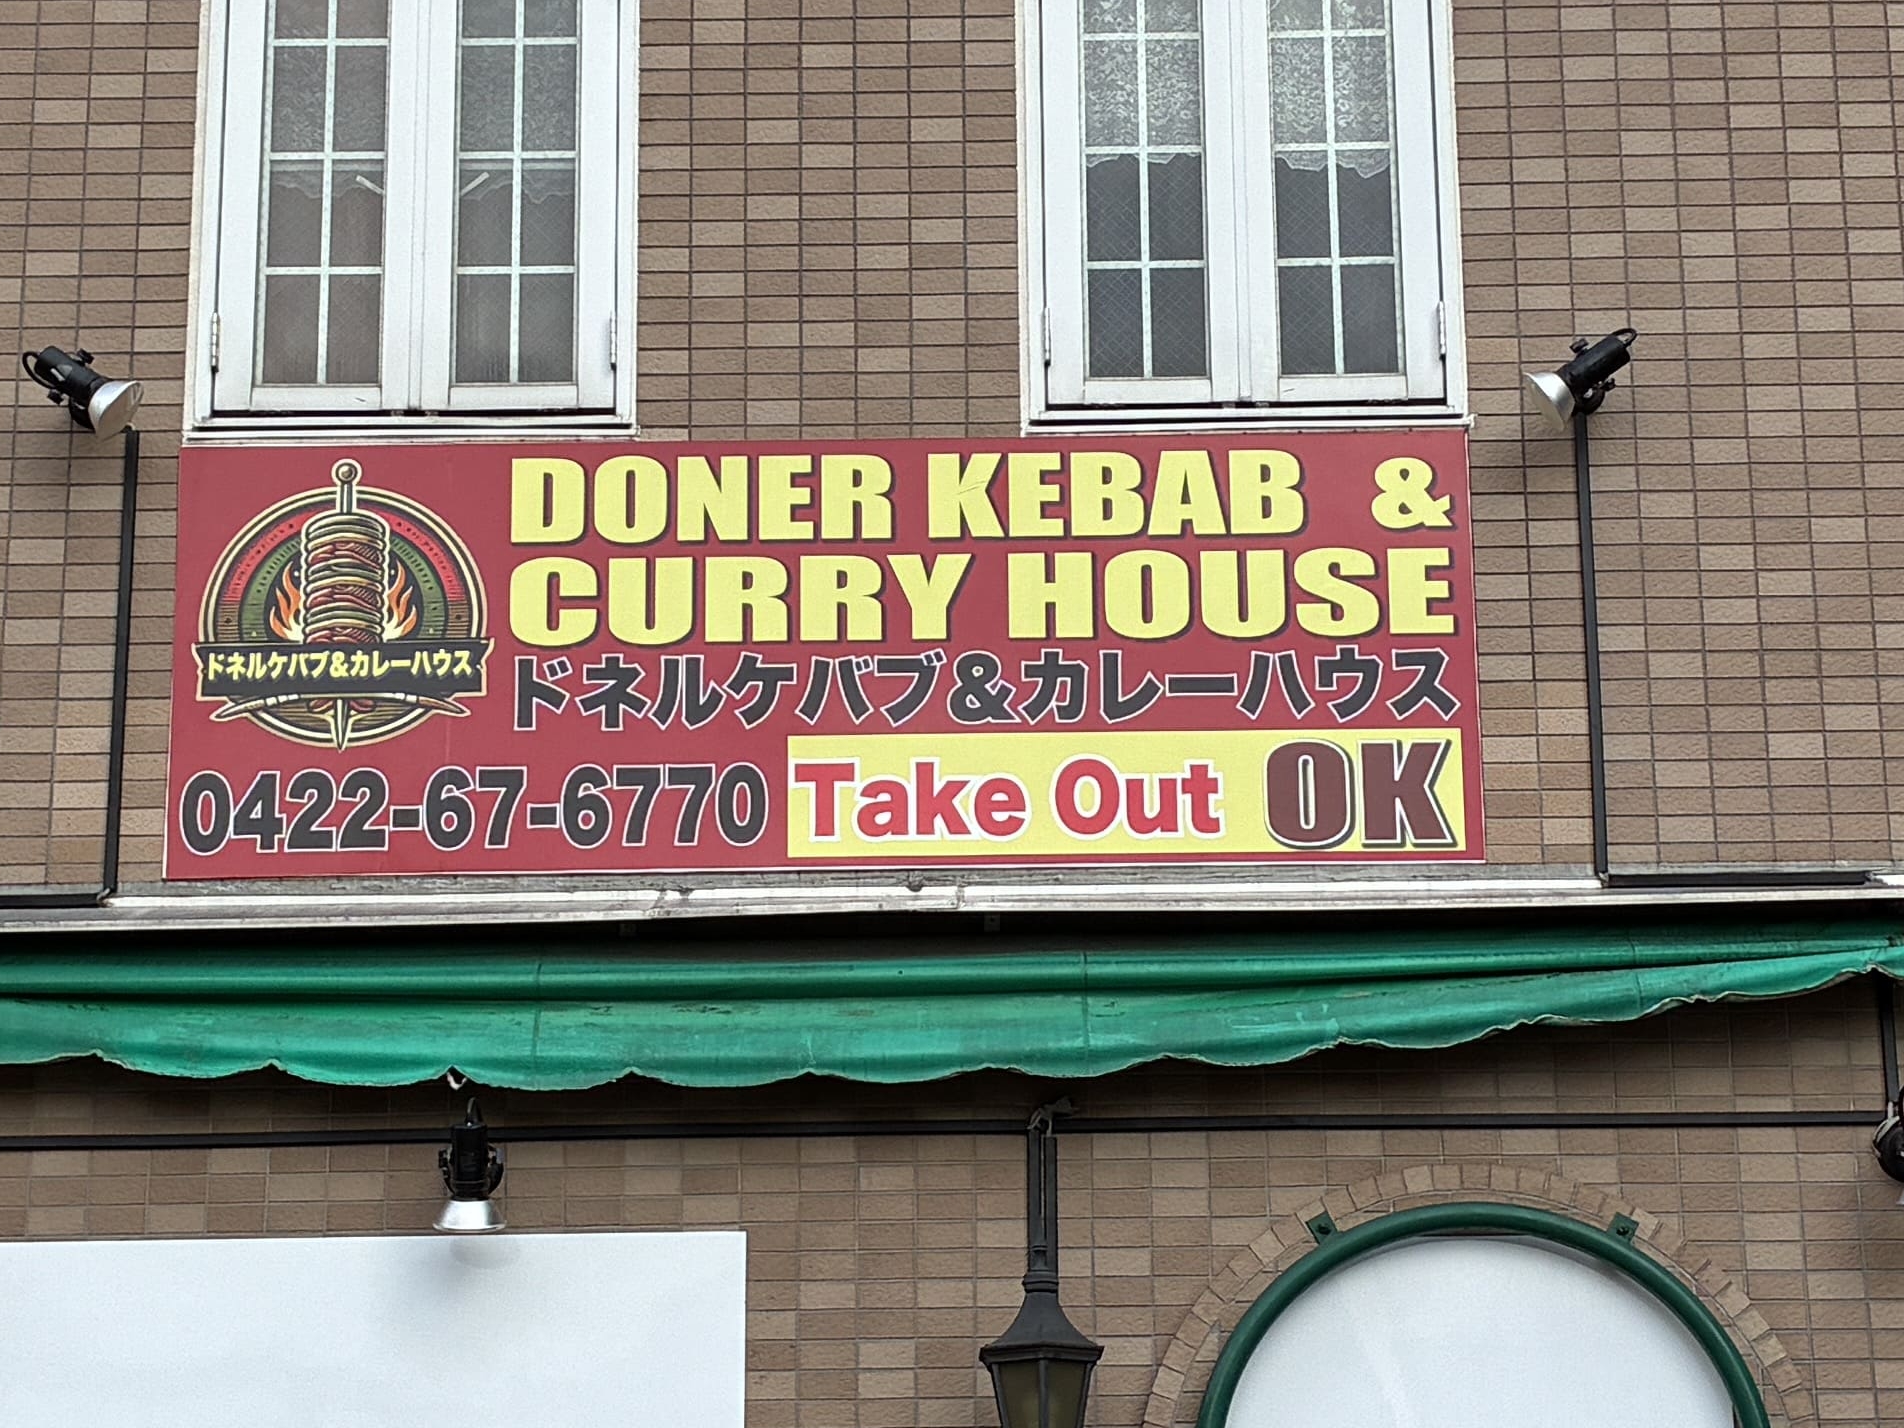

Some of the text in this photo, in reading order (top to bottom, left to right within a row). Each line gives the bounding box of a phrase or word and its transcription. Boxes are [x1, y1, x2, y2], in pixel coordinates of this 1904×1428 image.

[510, 449, 1453, 542] DONER KEBAB &
[509, 547, 1457, 646] CURRY HOUSE
[207, 649, 474, 681] ドネルケバブ&カレーハウス
[512, 645, 1460, 732] ドネルケバブ&カレーハウス
[180, 762, 770, 856] 0422-67-6770
[791, 736, 1461, 850] Take Out OK
